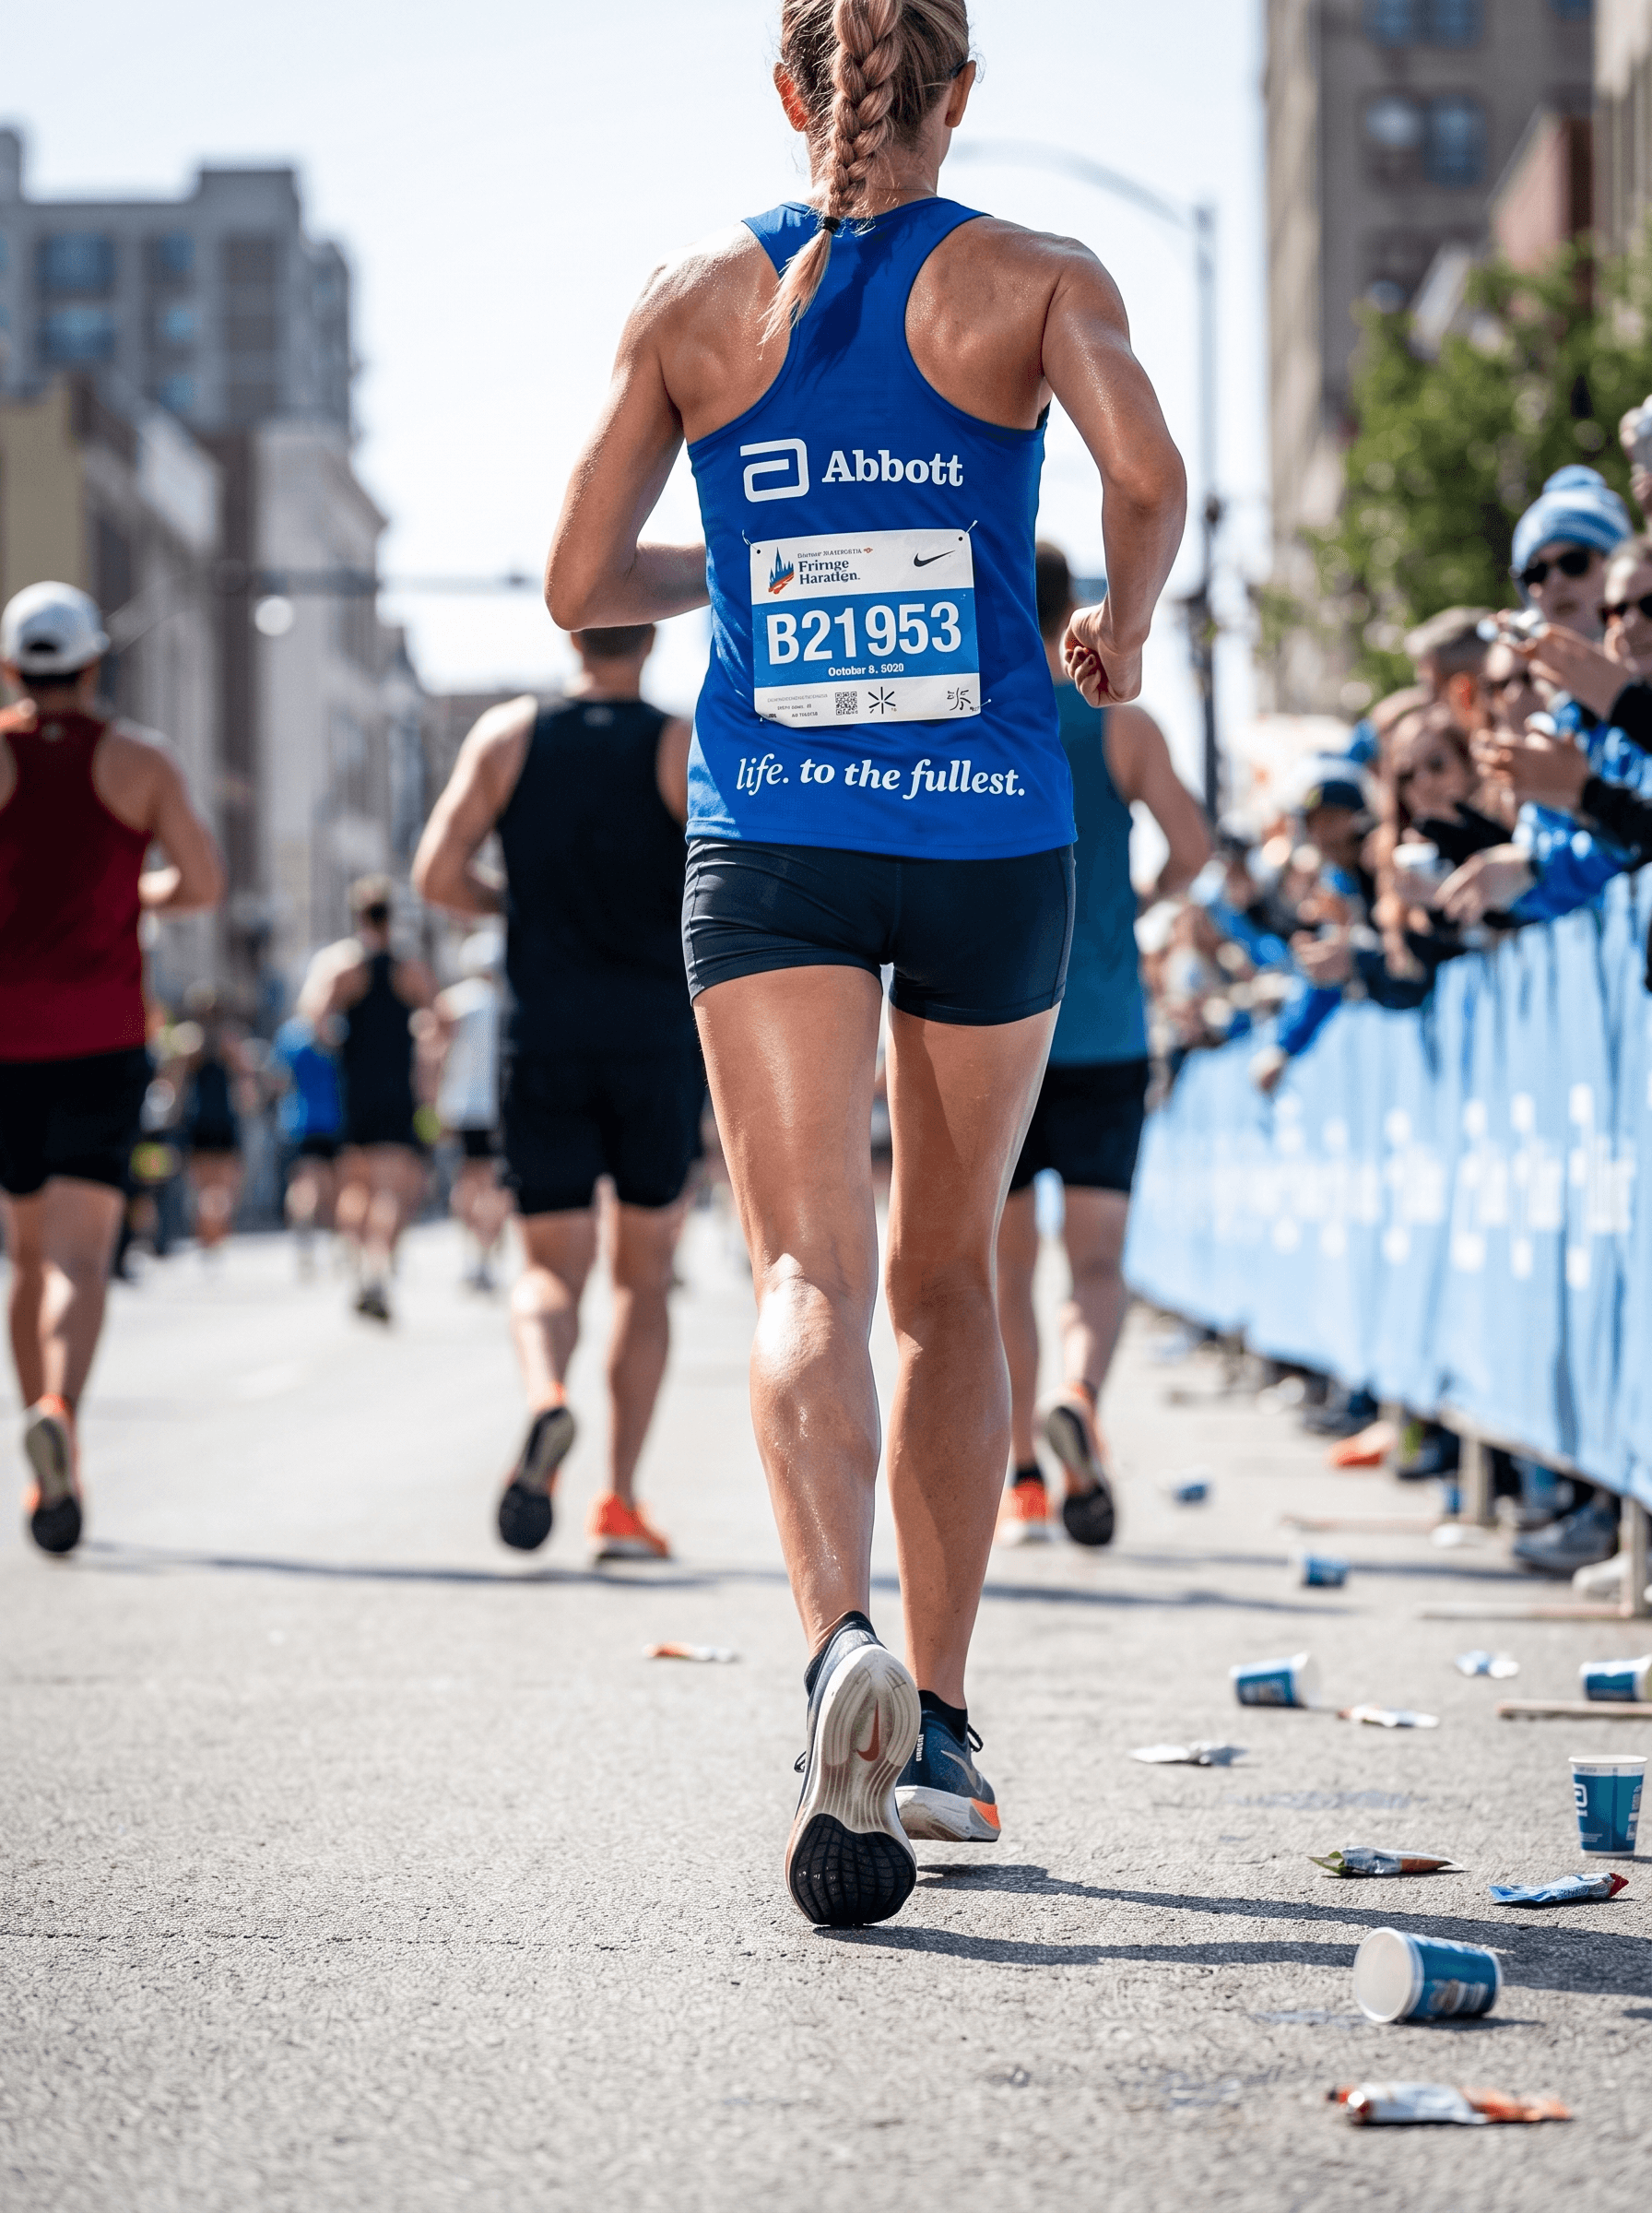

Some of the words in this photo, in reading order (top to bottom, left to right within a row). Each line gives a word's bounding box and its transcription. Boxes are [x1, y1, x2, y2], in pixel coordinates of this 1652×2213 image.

[822, 449, 963, 487] Abbott
[766, 601, 962, 665] B21953
[736, 753, 790, 796] life.
[799, 759, 836, 784] to
[844, 760, 901, 789] the
[903, 758, 1026, 800] fullest.
